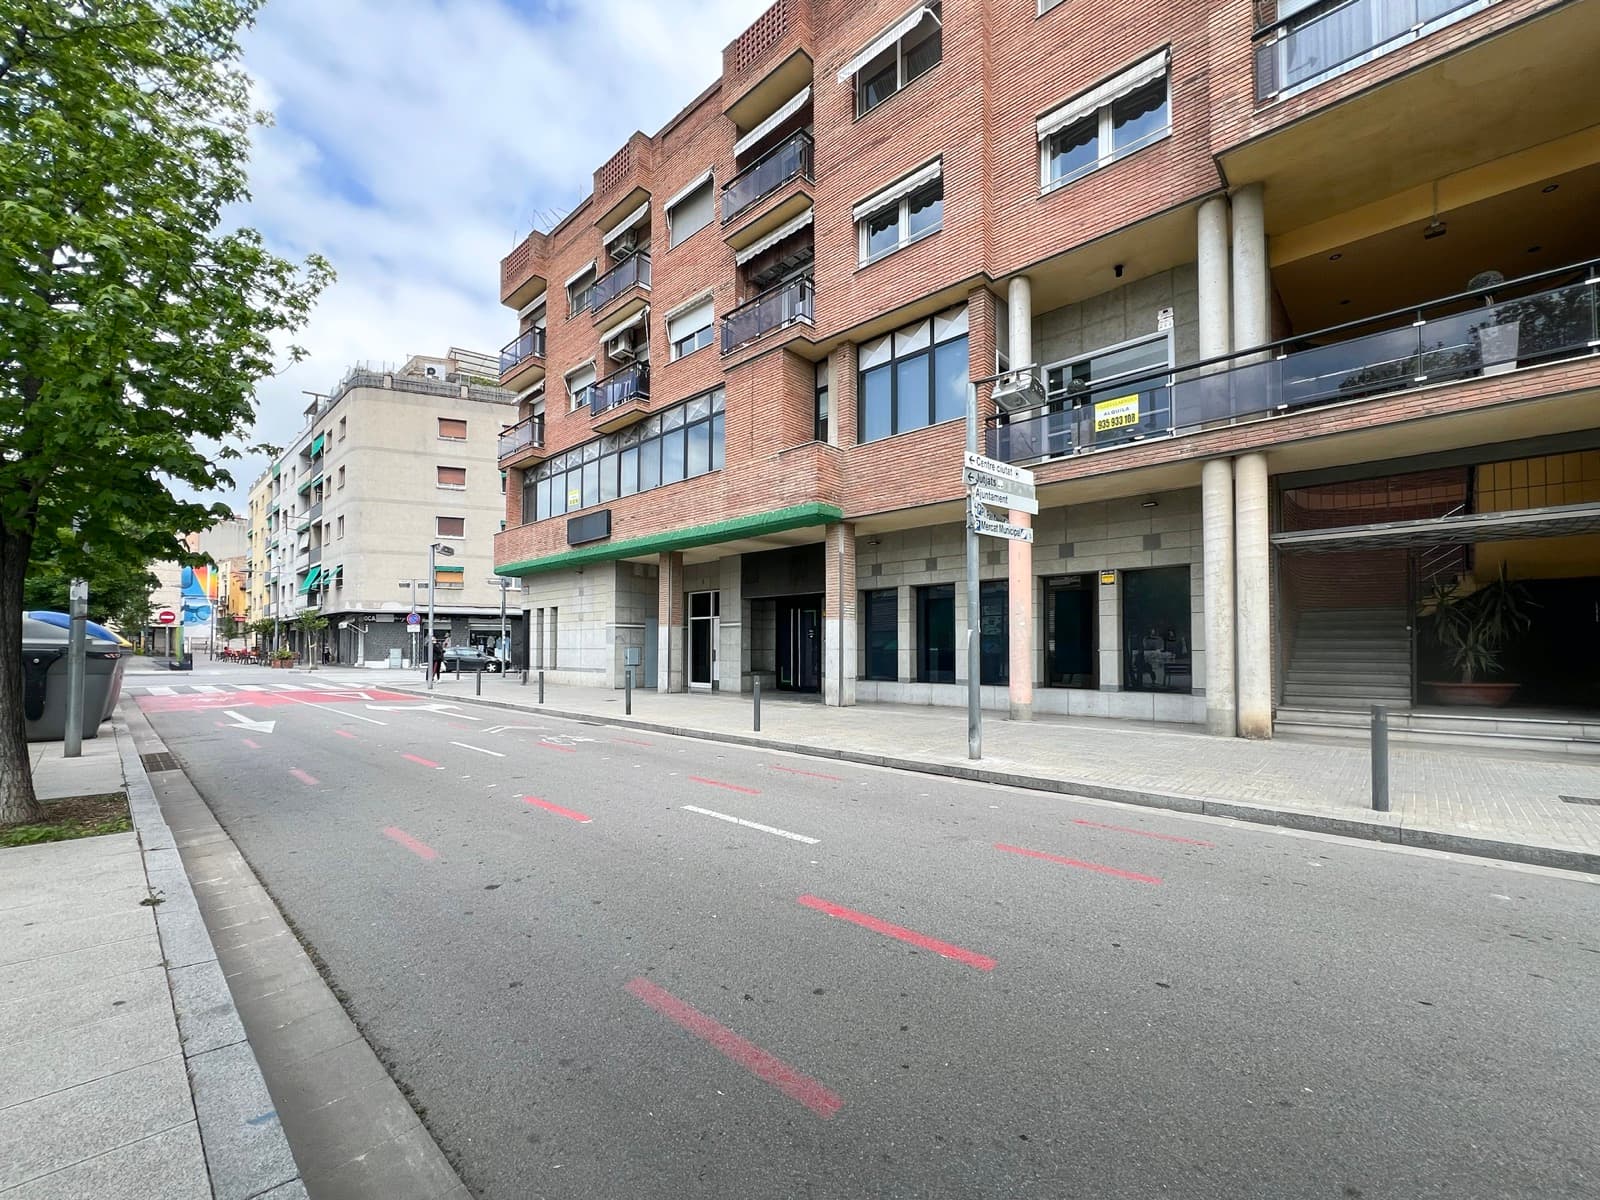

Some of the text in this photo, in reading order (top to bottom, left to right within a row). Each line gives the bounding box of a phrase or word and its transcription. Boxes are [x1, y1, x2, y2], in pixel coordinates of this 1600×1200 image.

[1098, 418, 1110, 430] 935
[1111, 415, 1123, 427] 933
[976, 457, 1013, 476] Centre ciutat
[975, 488, 1008, 504] Ajuntament
[981, 520, 998, 532] Mercat
[998, 524, 1022, 538] Municipal
